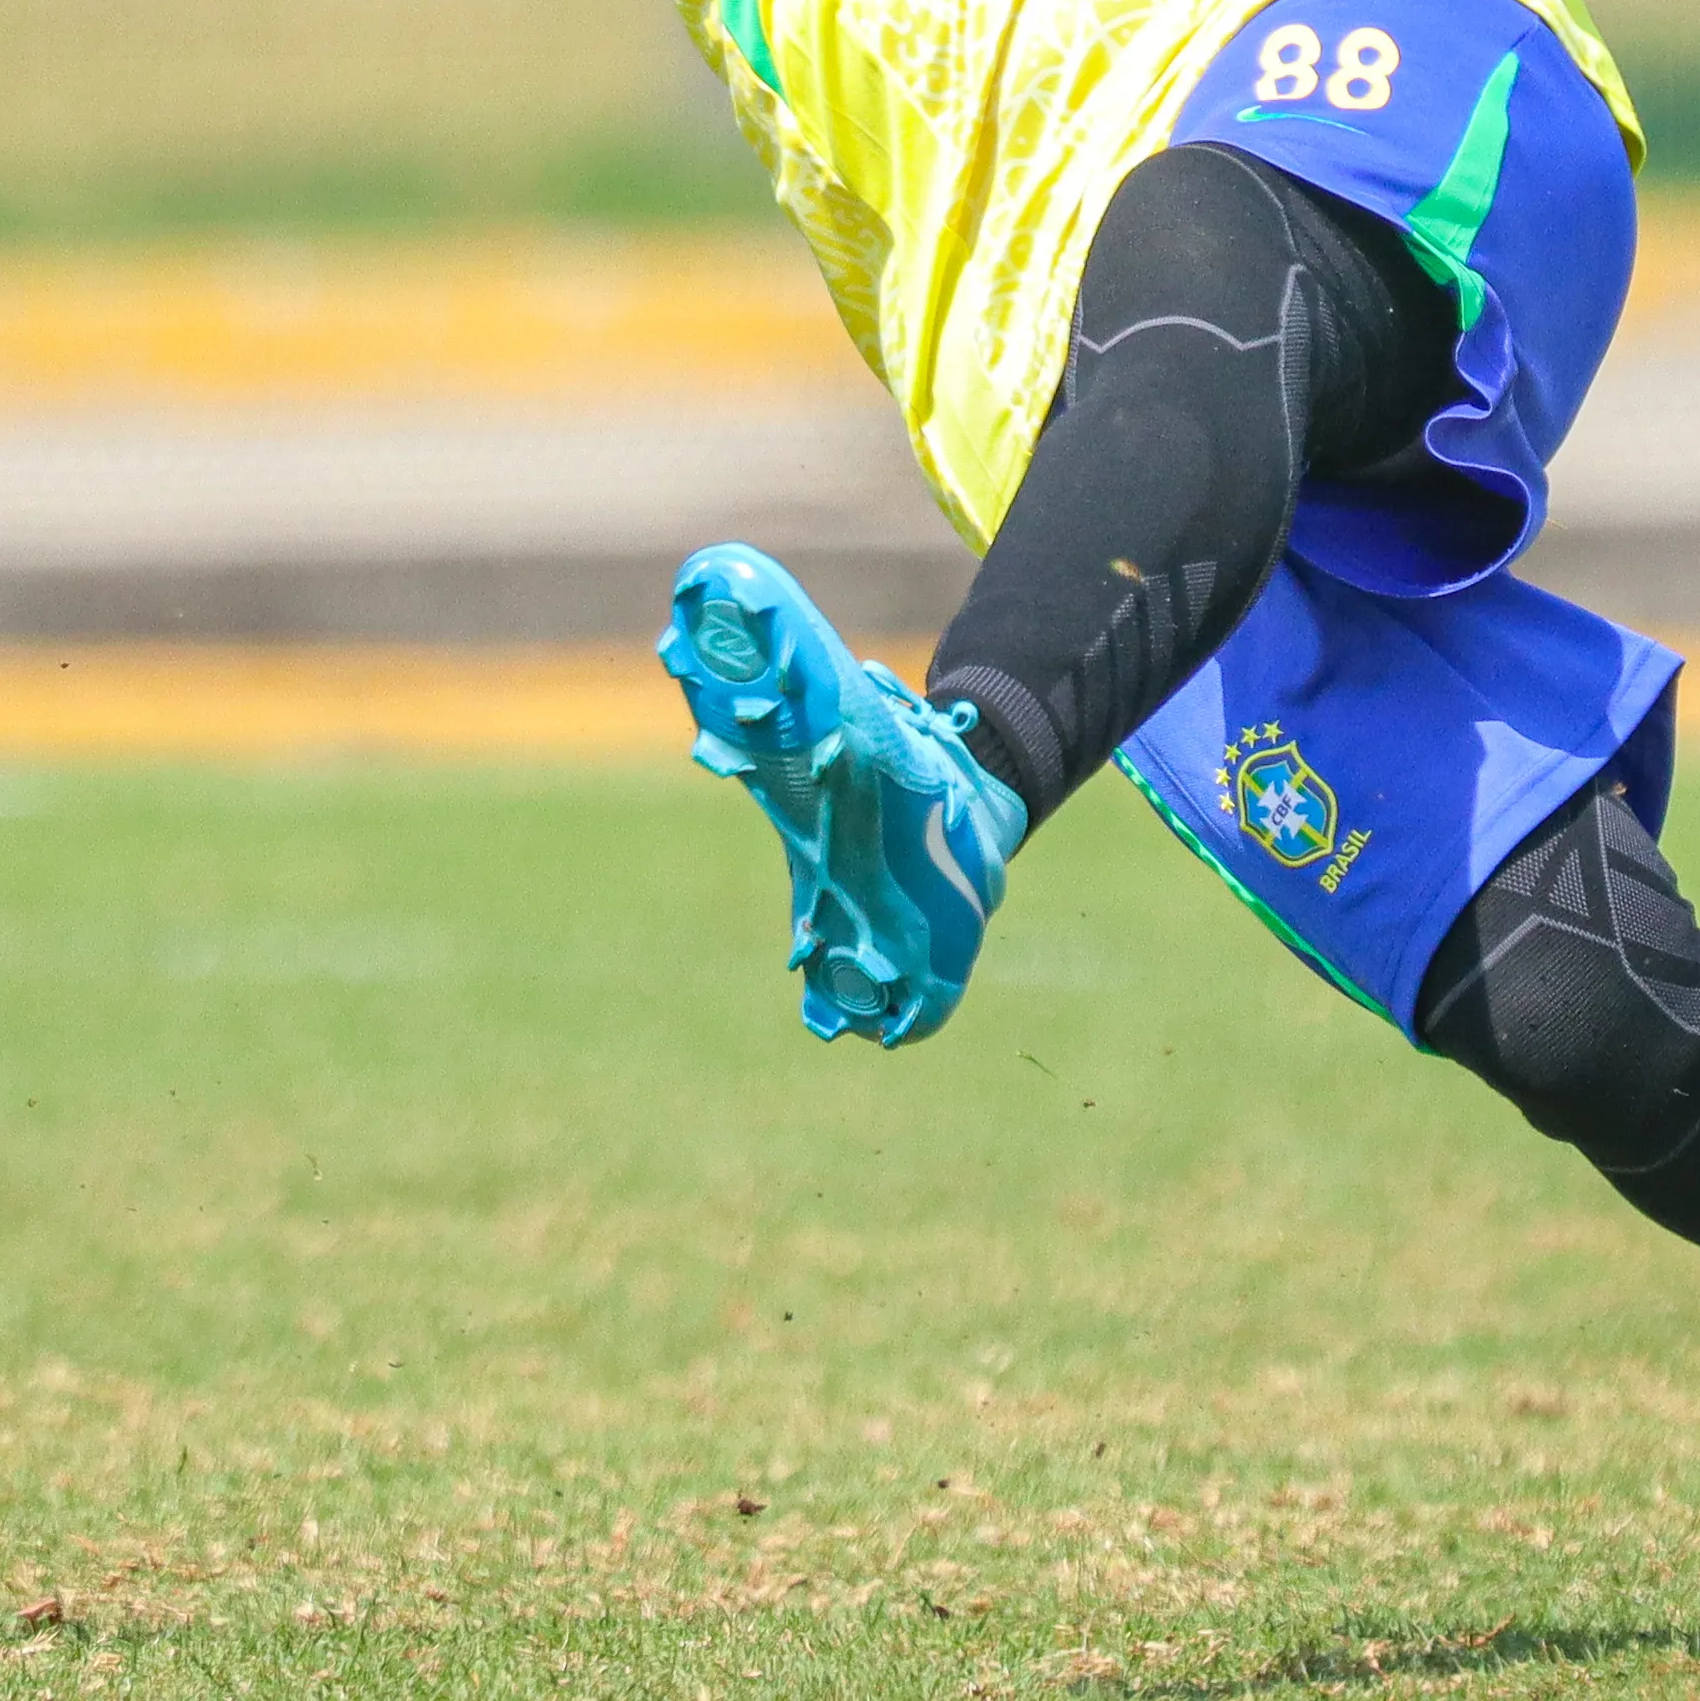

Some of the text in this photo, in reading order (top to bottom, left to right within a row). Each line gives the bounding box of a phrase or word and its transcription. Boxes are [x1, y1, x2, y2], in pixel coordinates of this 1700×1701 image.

[1255, 23, 1401, 110] 88
[1271, 793, 1292, 826] CBF
[1319, 829, 1372, 894] BRASIL
